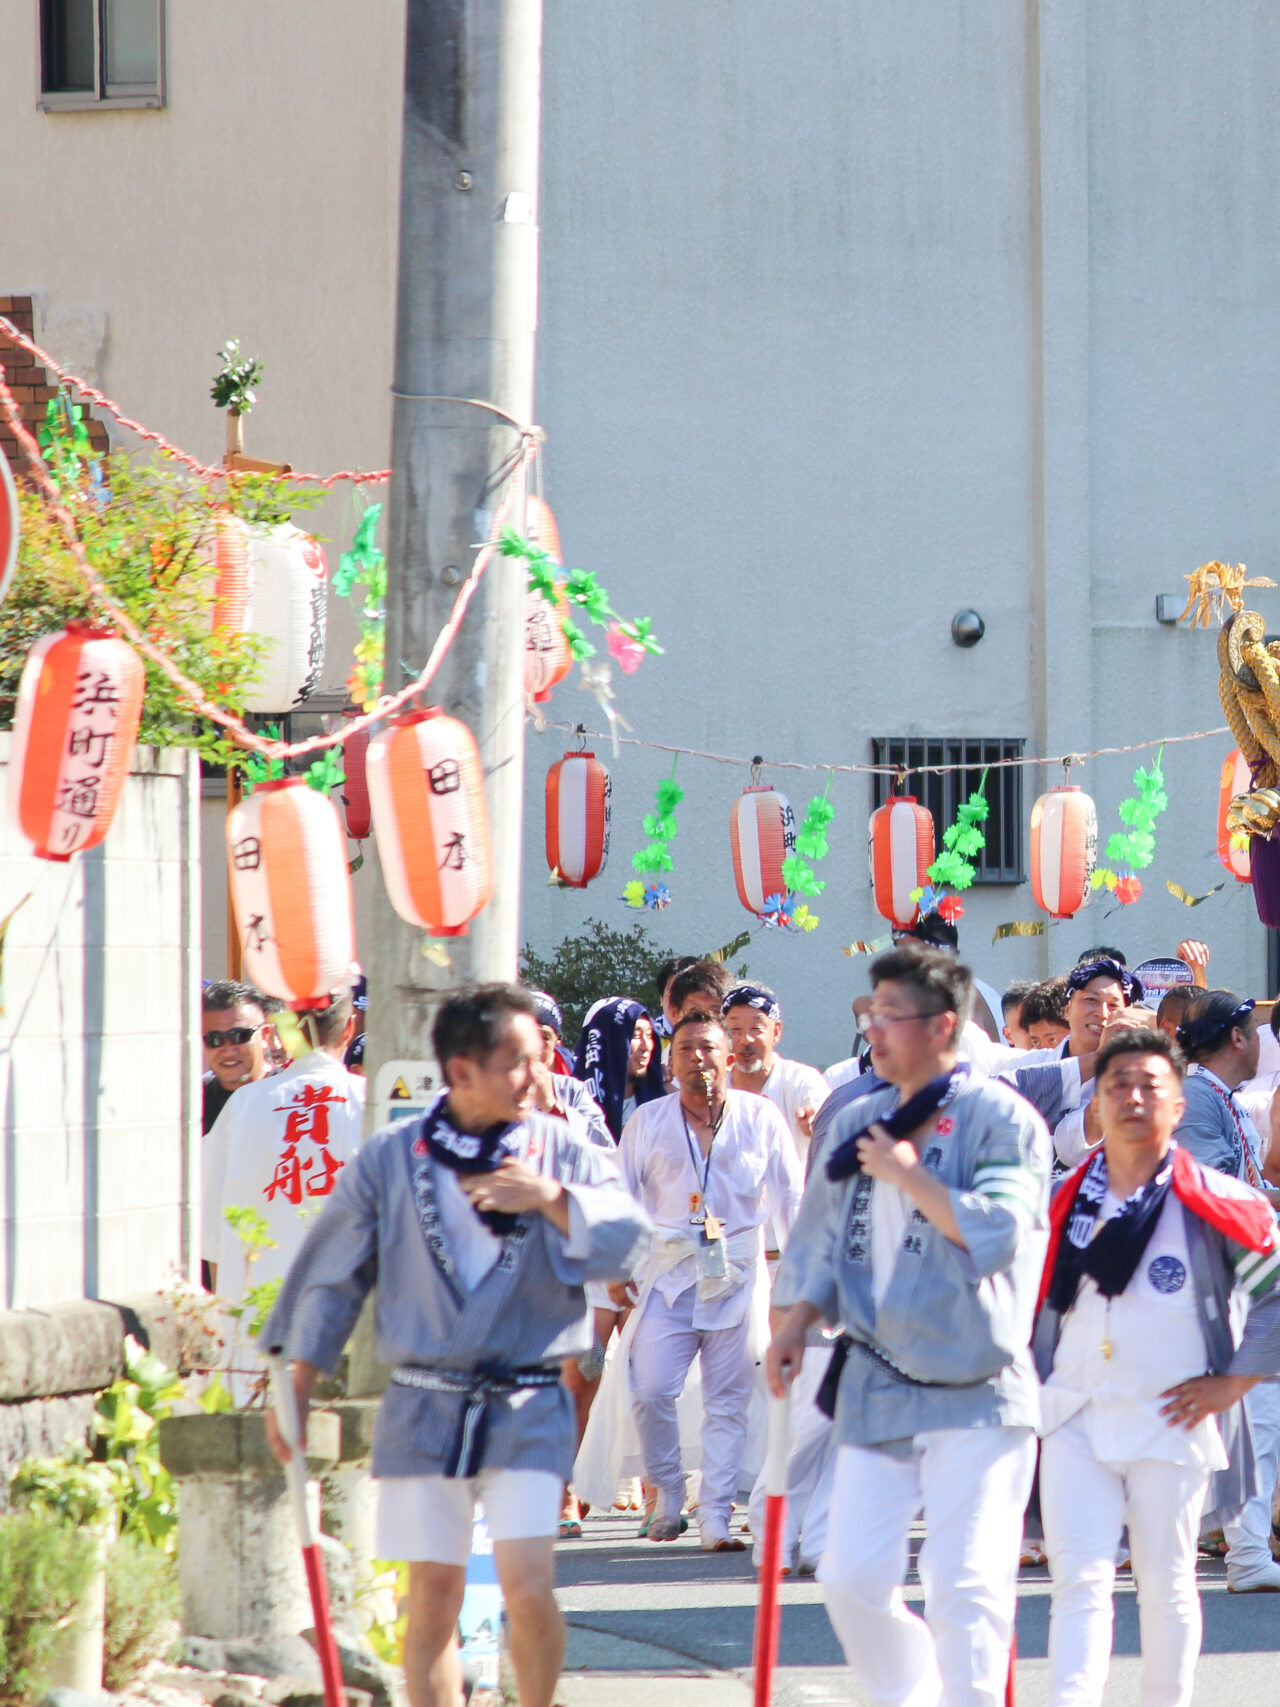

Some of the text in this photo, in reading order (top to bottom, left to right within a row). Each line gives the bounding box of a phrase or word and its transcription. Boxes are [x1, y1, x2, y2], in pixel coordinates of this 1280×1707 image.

[54, 672, 120, 849] 浜町通り
[262, 1084, 348, 1205] 貴船
